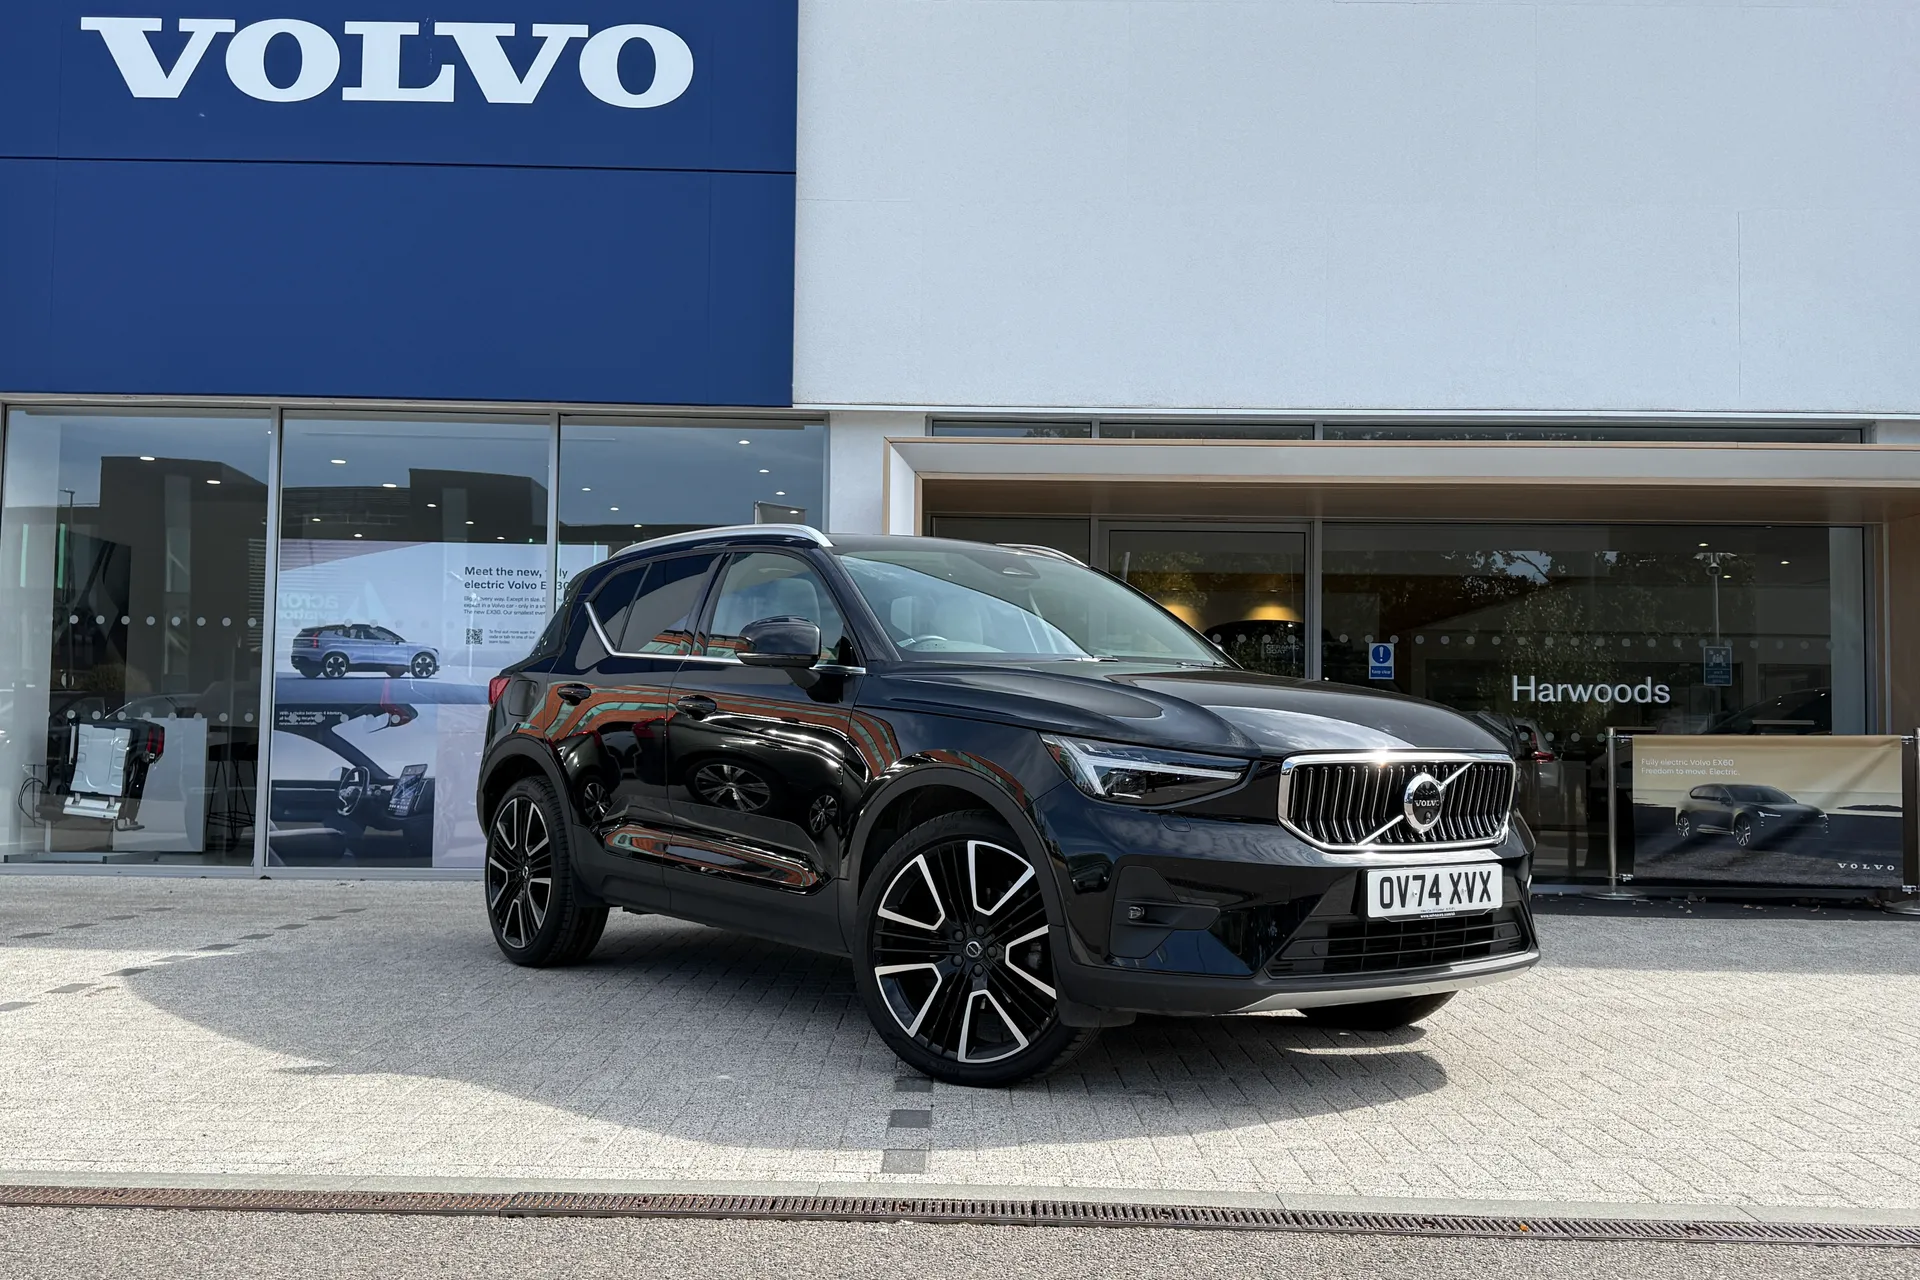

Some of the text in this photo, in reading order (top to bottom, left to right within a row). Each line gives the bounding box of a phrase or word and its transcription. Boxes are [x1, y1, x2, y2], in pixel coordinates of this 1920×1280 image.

[80, 16, 695, 109] VOLVO
[464, 566, 494, 576] Meet
[496, 567, 514, 576] the
[516, 568, 542, 578] new,
[464, 580, 570, 590] electric Volvo E30
[1512, 674, 1671, 704] Harwoods
[1641, 758, 1659, 768] Fully
[1836, 862, 1895, 871] VOLVO
[1380, 870, 1492, 910] OV74 XVX
